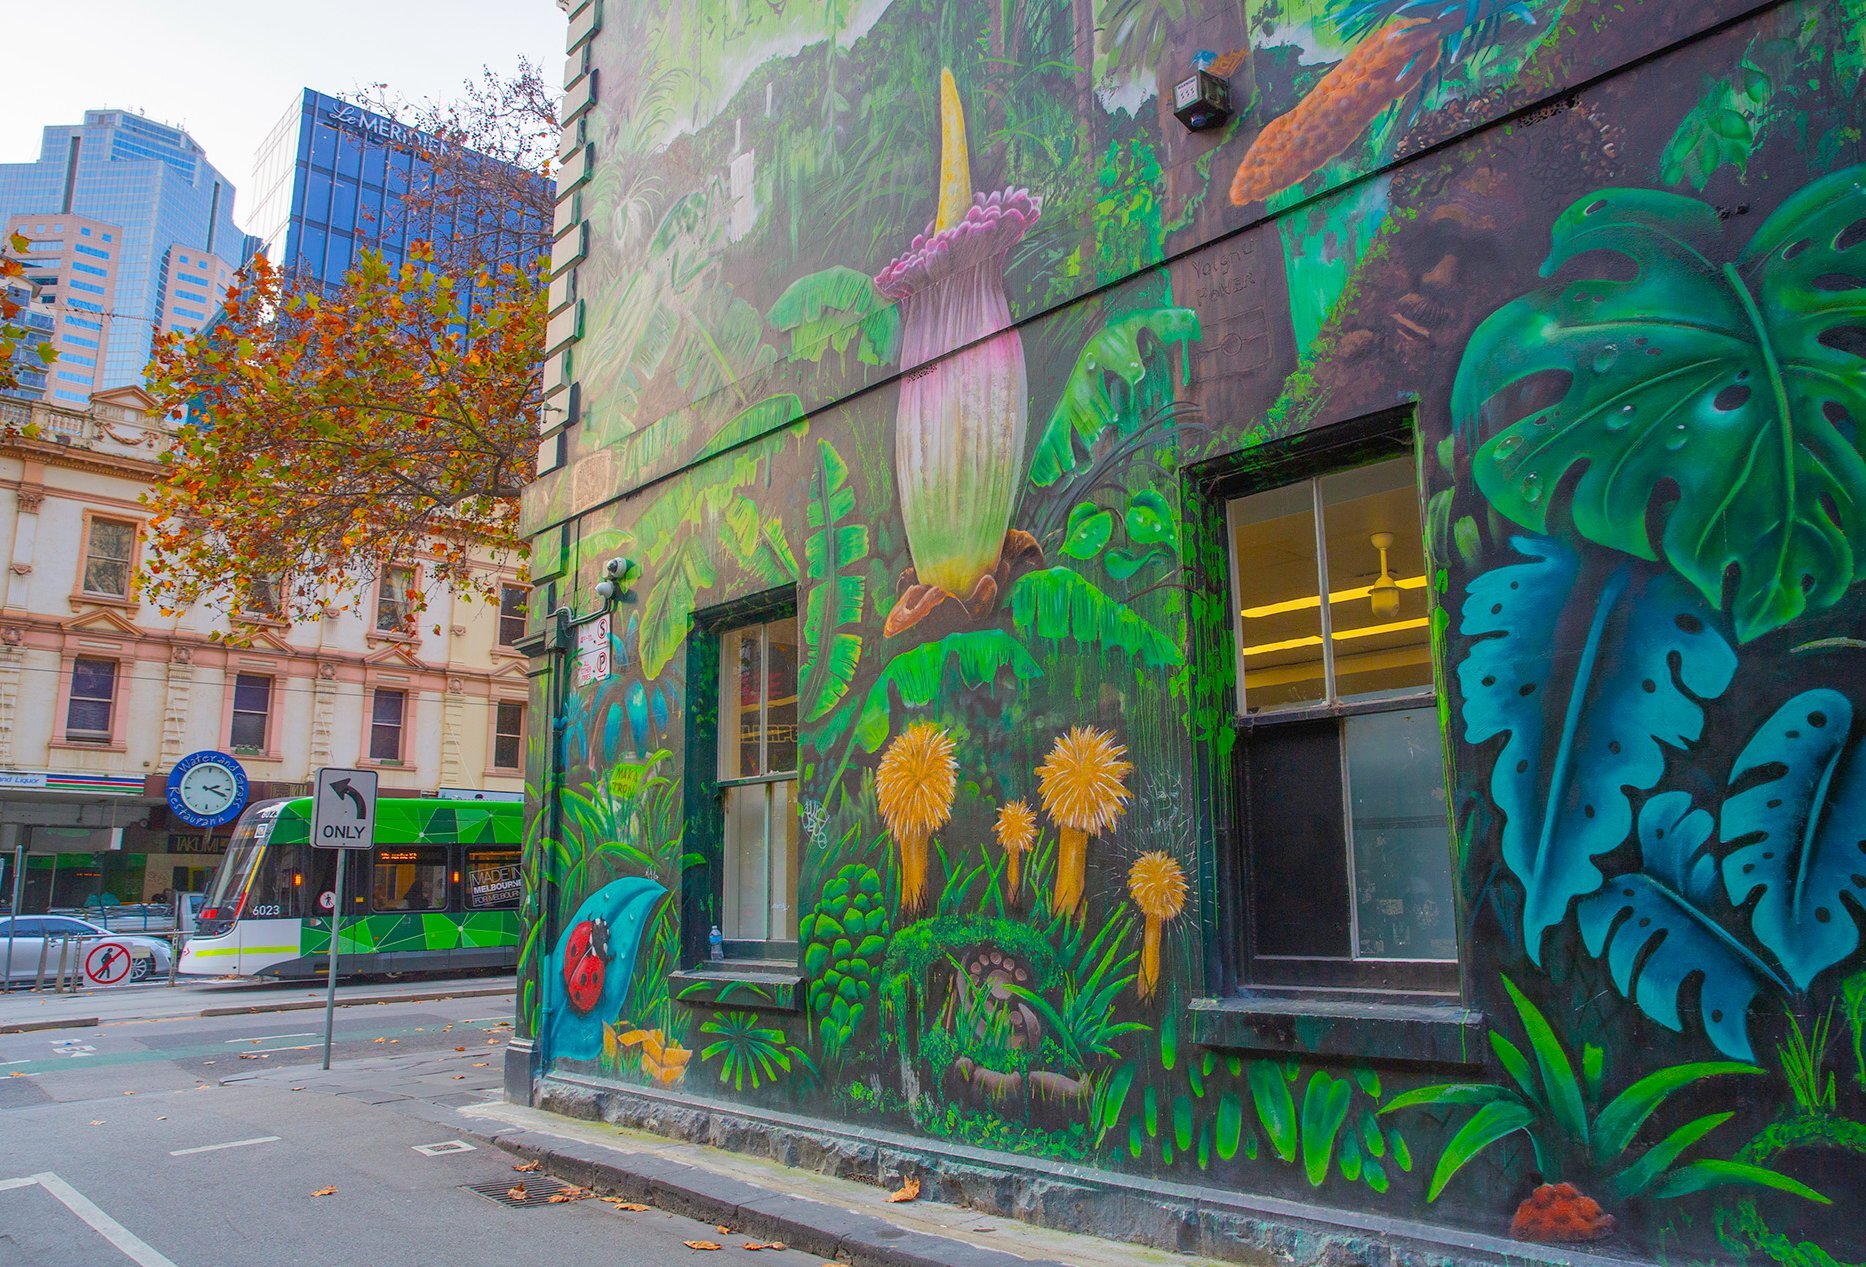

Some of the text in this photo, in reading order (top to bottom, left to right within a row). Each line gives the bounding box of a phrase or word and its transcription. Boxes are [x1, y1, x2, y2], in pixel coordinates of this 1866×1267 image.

[329, 103, 356, 125] Le
[15, 776, 40, 784] Liquor
[178, 753, 246, 808] Water and Grass
[612, 782, 635, 795] TRON
[322, 825, 366, 839] ONLY
[472, 868, 510, 886] MADE
[474, 879, 521, 894] MELBOURN
[475, 896, 488, 904] FOR
[252, 905, 280, 916] 6023
